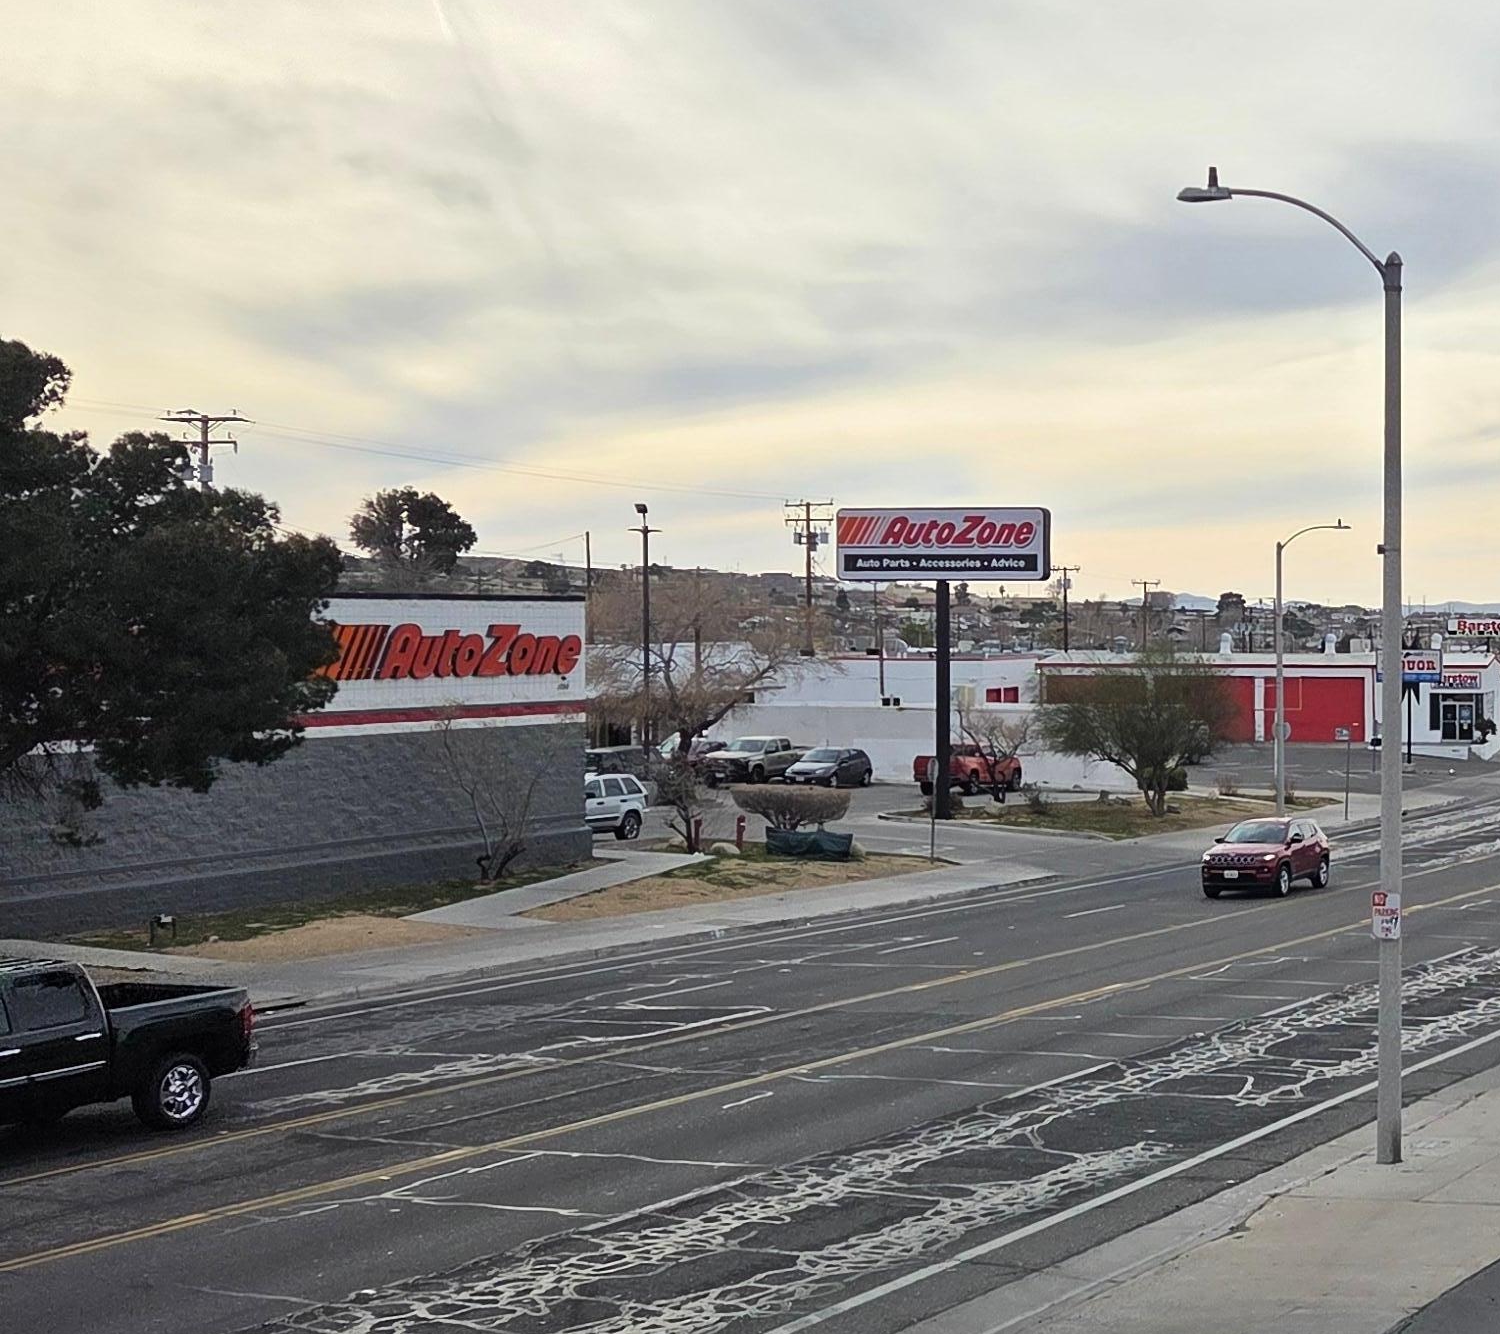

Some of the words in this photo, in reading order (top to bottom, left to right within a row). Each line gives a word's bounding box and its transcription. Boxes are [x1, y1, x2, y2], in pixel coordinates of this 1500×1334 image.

[880, 515, 1036, 546] AutoZone
[856, 558, 880, 568] Auto
[883, 558, 910, 568] Parts
[919, 558, 981, 568] Accessories
[990, 558, 1025, 568] Advice
[374, 623, 582, 680] AutoZone
